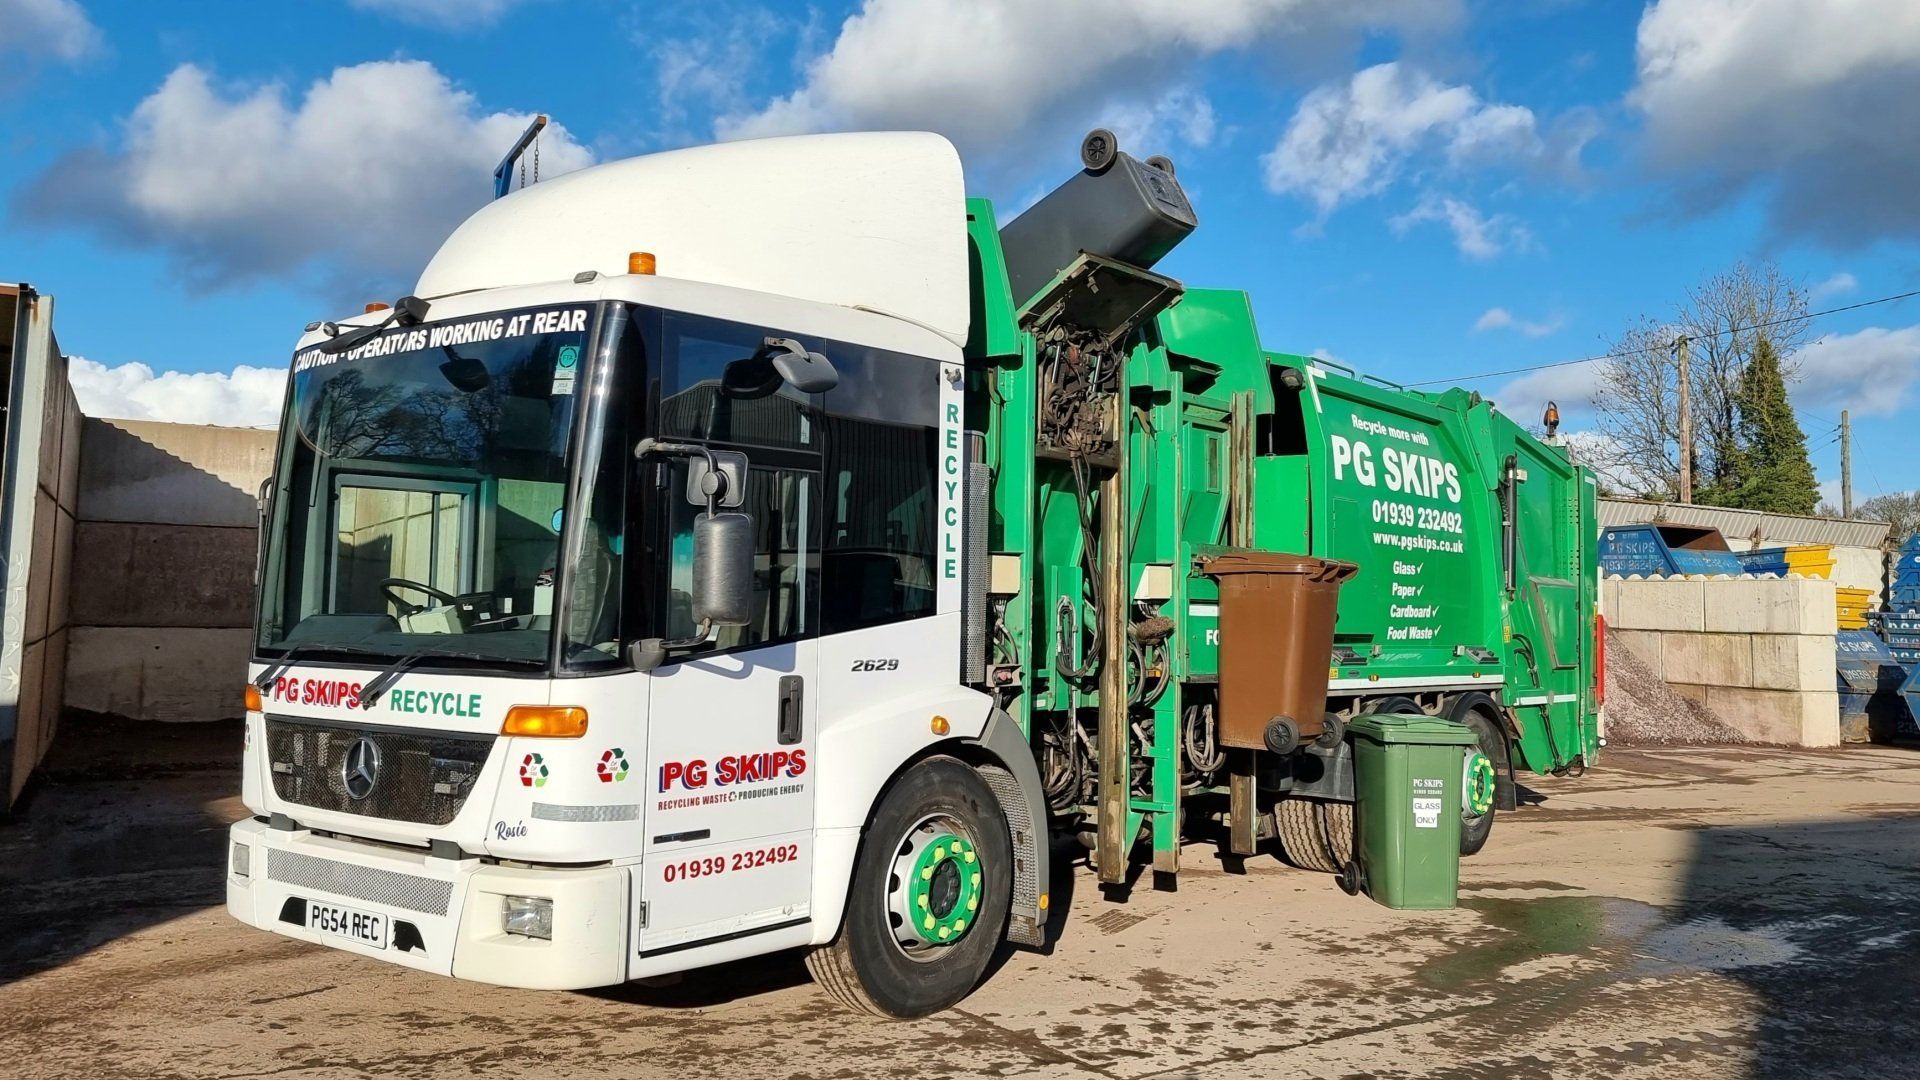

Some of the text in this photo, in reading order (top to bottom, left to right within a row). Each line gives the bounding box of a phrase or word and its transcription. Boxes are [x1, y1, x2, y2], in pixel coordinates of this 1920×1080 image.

[295, 349, 337, 372] CAUTION
[347, 329, 427, 361] OPERATORS
[429, 318, 503, 348] WORKING
[505, 315, 532, 338] AT
[532, 309, 587, 334] REAR
[1351, 413, 1429, 446] Recycle more with
[1330, 434, 1462, 503] PG SKIPS
[945, 403, 959, 579] RECYCLE
[1372, 499, 1463, 534] 01939 232492
[1373, 532, 1464, 553] www.pgskips.co.uk
[1392, 560, 1416, 575] Glass
[1391, 582, 1416, 599] Paper
[1390, 604, 1432, 618] Cardboard
[1386, 626, 1433, 640] Food Waste
[851, 658, 899, 671] 2629
[274, 676, 361, 710] PG SKIPS
[390, 689, 482, 718] RECYCLE
[659, 749, 807, 793] PG SKIPS
[1424, 779, 1443, 788] SKIPS
[658, 783, 804, 811] RECYCLING WASTE PRODUCING ENERGY
[1414, 802, 1440, 810] GLASS
[495, 820, 528, 841] Rosie
[1416, 816, 1436, 824] ONLY
[664, 844, 798, 883] 01939 232492
[312, 905, 379, 941] PG54 REC
